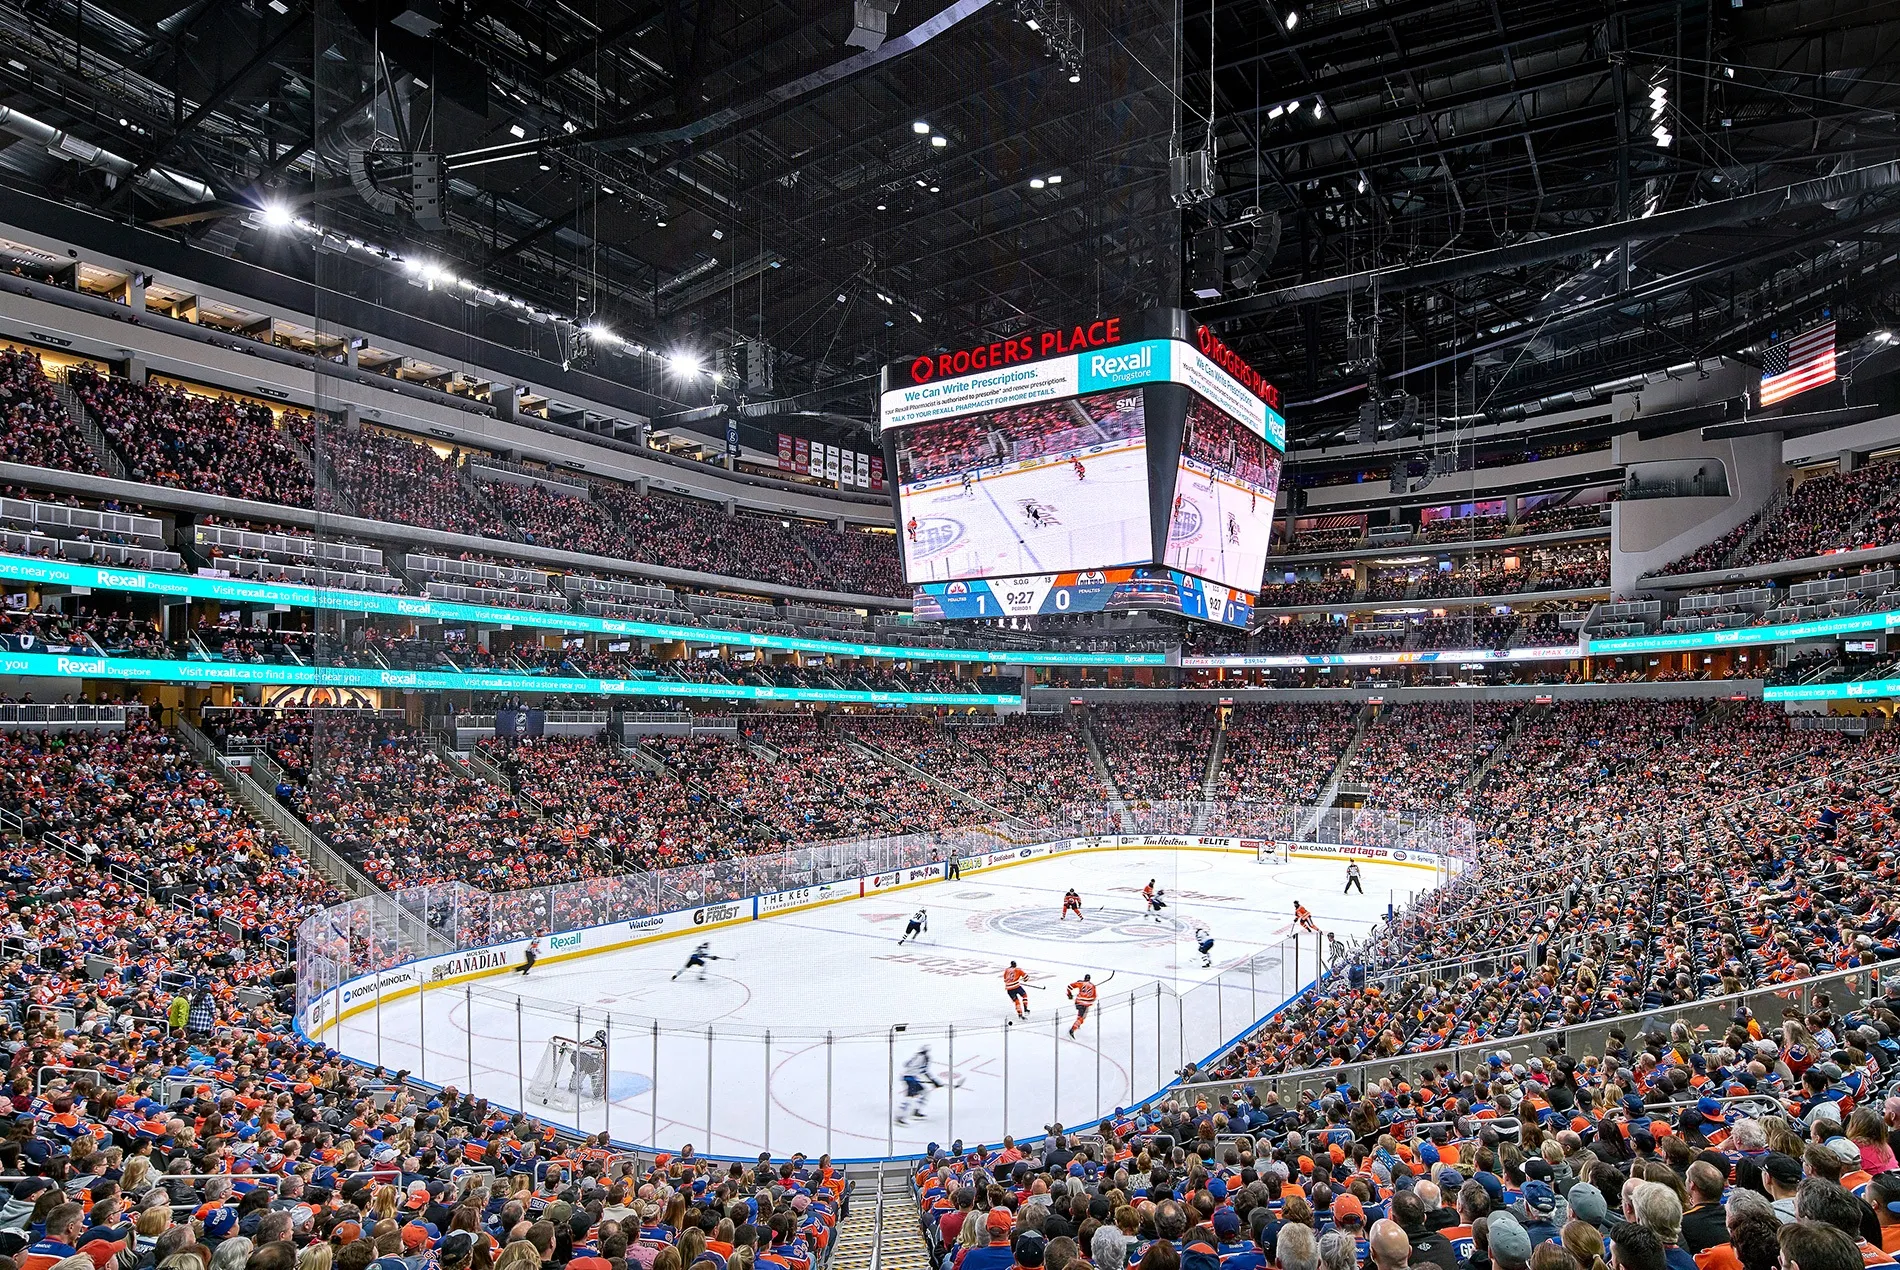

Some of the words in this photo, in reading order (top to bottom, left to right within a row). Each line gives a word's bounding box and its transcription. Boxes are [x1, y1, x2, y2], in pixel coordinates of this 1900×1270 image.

[939, 336, 1032, 376] ROGERS
[1042, 318, 1120, 355] PLACE
[1091, 346, 1150, 377] Rexall
[1112, 369, 1151, 382] Drugstore
[1212, 336, 1250, 386] ROGERS
[1253, 371, 1278, 409] PLACE
[905, 393, 920, 402] We
[922, 387, 940, 398] Can
[942, 382, 969, 395] Write
[910, 401, 936, 411] Pharmacist
[941, 394, 968, 404] authorized
[932, 407, 954, 415] REXALL
[955, 400, 993, 411] PHARMACIST
[1009, 393, 1027, 401] MORE
[20, 568, 45, 576] near
[97, 571, 146, 588] Rexall
[147, 583, 188, 591] Drugstore
[213, 586, 235, 594] Visit
[236, 590, 278, 599] rexall.ca
[291, 593, 310, 602] find
[319, 596, 342, 605] store
[1006, 591, 1034, 605] 9:27
[1056, 589, 1070, 610] 0
[398, 602, 430, 614] Rexall
[976, 595, 984, 614] 1
[602, 622, 625, 631] Rexall
[1715, 633, 1739, 642] Rexall
[6, 661, 29, 670] you
[57, 658, 106, 674] Rexall
[107, 668, 151, 676] Drugstore
[179, 668, 203, 676] Visit
[204, 668, 251, 678] rexall.ca
[264, 670, 285, 679] find
[294, 671, 320, 680] store
[381, 672, 417, 685] Rexall
[600, 681, 624, 691] Rexall
[1143, 836, 1157, 845] Tim
[1157, 836, 1188, 845] Hortons
[1203, 838, 1229, 846] ELITE
[1310, 845, 1336, 853] CANADA
[994, 853, 1015, 862] Scotiabank
[763, 894, 783, 905] THE
[789, 889, 809, 900] KEG
[705, 907, 740, 923] FROST
[628, 917, 663, 930] Waterloo
[550, 932, 581, 950] Rexall
[466, 949, 489, 957] MOLSON
[449, 951, 507, 975] CANADIAN
[351, 983, 378, 999] KONICA
[379, 973, 411, 990] MINOLTA
